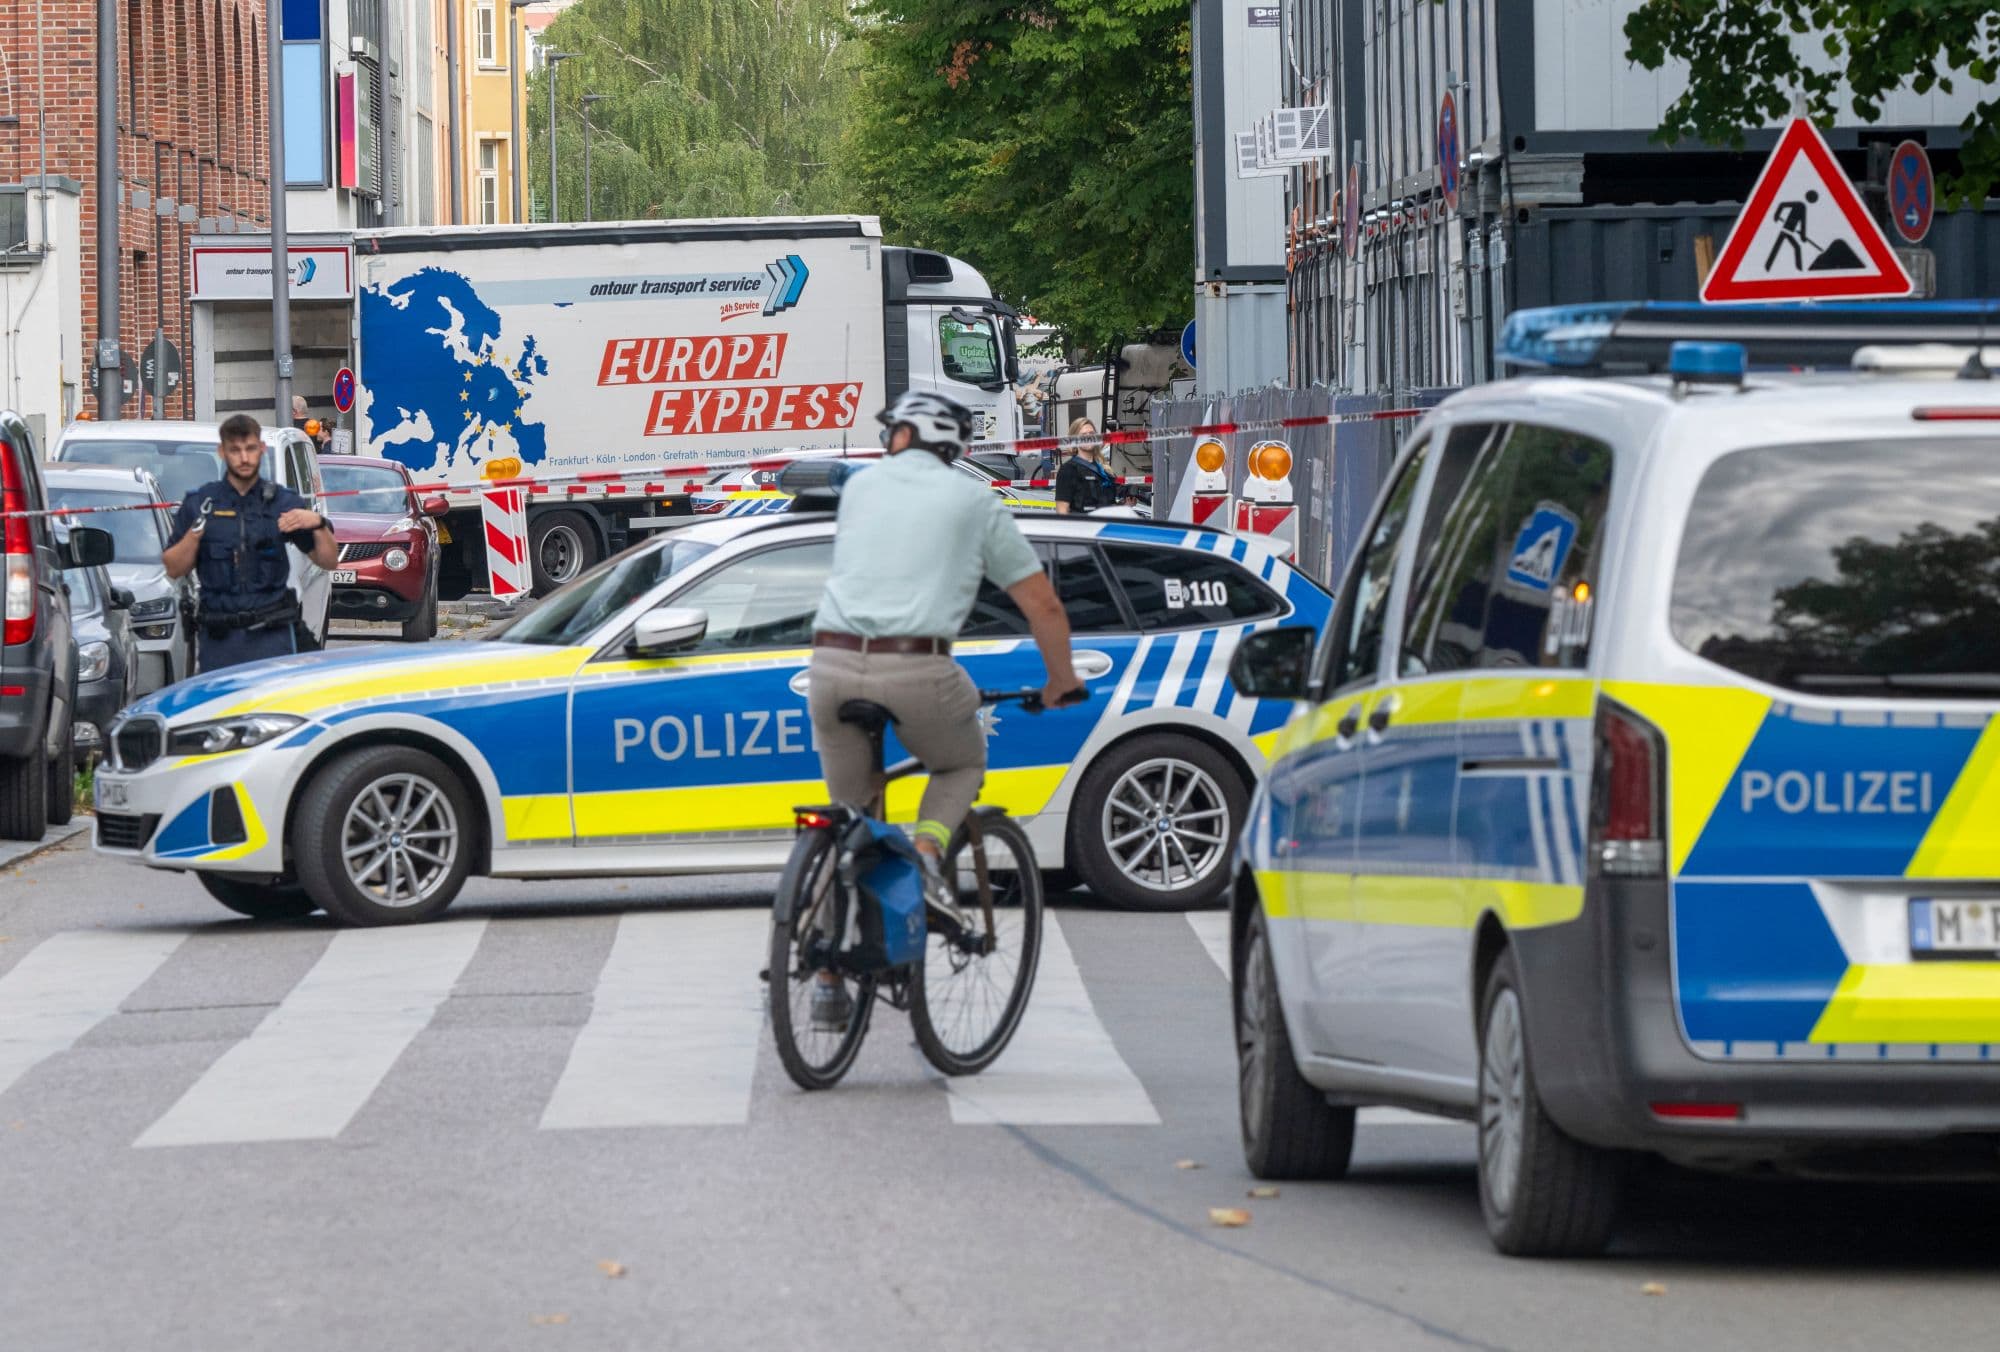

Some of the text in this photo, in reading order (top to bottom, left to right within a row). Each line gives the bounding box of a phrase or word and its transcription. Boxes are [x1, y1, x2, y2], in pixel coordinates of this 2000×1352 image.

[225, 268, 245, 276] ontour
[590, 276, 761, 296] ontour transport service
[720, 300, 760, 315] 24h Service
[604, 335, 779, 384] EUROPA
[649, 384, 860, 434] EXPRESS
[549, 456, 589, 467] Frankfurt
[596, 454, 616, 464] Köln
[623, 452, 656, 463] London
[663, 450, 699, 461] Grefrath
[705, 447, 746, 458] Hamburg
[1190, 581, 1228, 606] 110
[1740, 770, 1933, 814] POLIZEI
[1936, 905, 1962, 942] M
